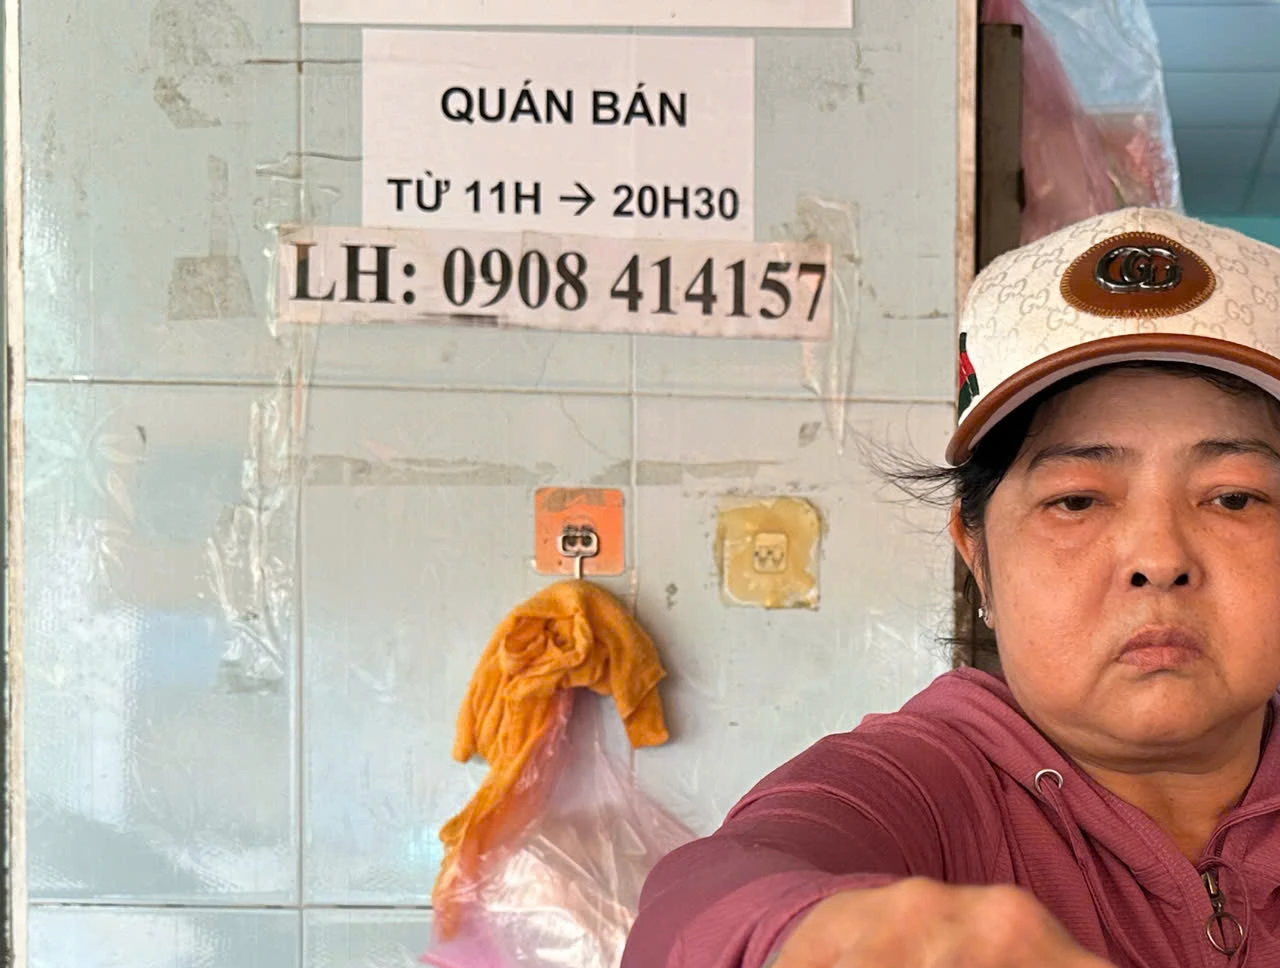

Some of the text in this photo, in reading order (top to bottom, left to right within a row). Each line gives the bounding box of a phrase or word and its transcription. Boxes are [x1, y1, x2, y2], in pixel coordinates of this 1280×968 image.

[440, 80, 687, 127] QUÁN BÁN
[387, 171, 740, 221] TỪ 11H 20H30
[289, 241, 827, 323] LH: 0908 414157
